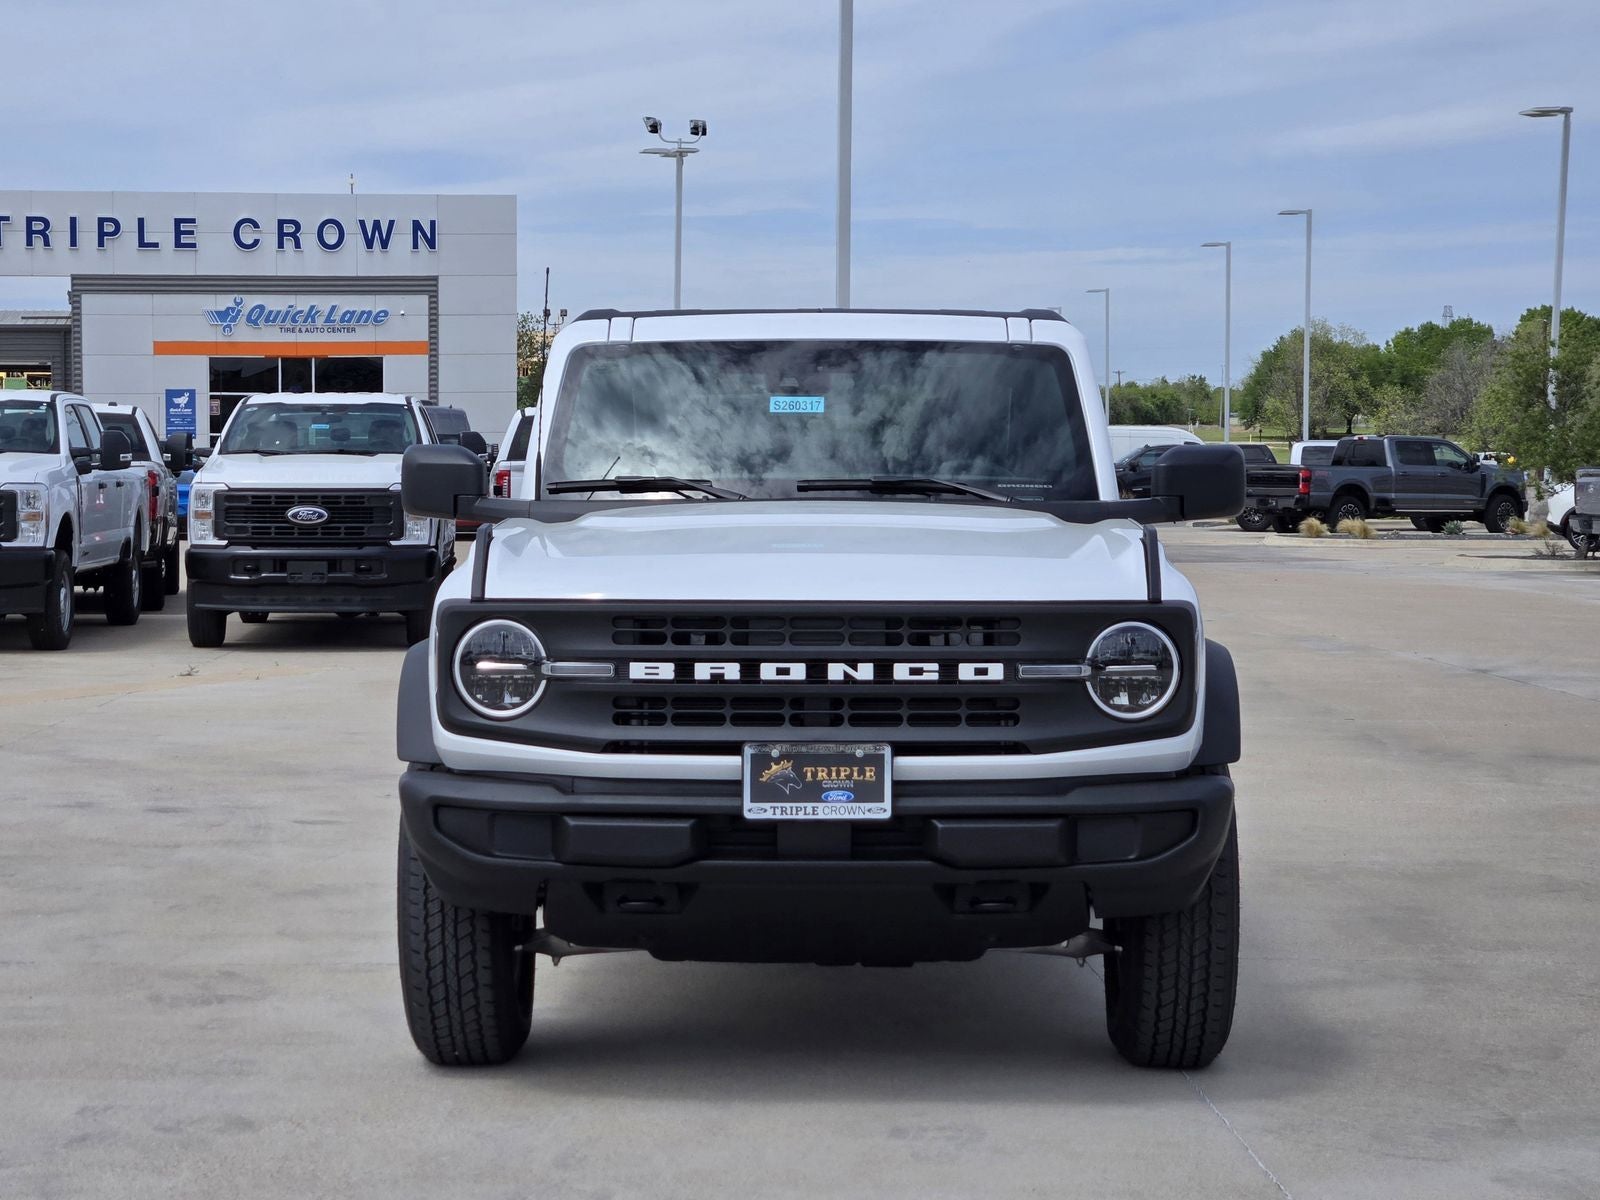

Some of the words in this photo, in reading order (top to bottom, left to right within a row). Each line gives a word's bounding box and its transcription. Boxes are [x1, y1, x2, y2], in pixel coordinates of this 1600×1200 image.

[232, 217, 438, 251] CROWN
[245, 303, 321, 328] Quick
[322, 304, 390, 326] Lane
[773, 401, 821, 411] S260317
[297, 510, 318, 520] Ford
[629, 661, 1004, 681] BRONCO
[803, 767, 876, 781] TRIPLE
[822, 780, 854, 788] CROWN
[828, 791, 848, 801] Ford
[770, 805, 819, 816] TRIPLE
[822, 805, 866, 816] CROWN
